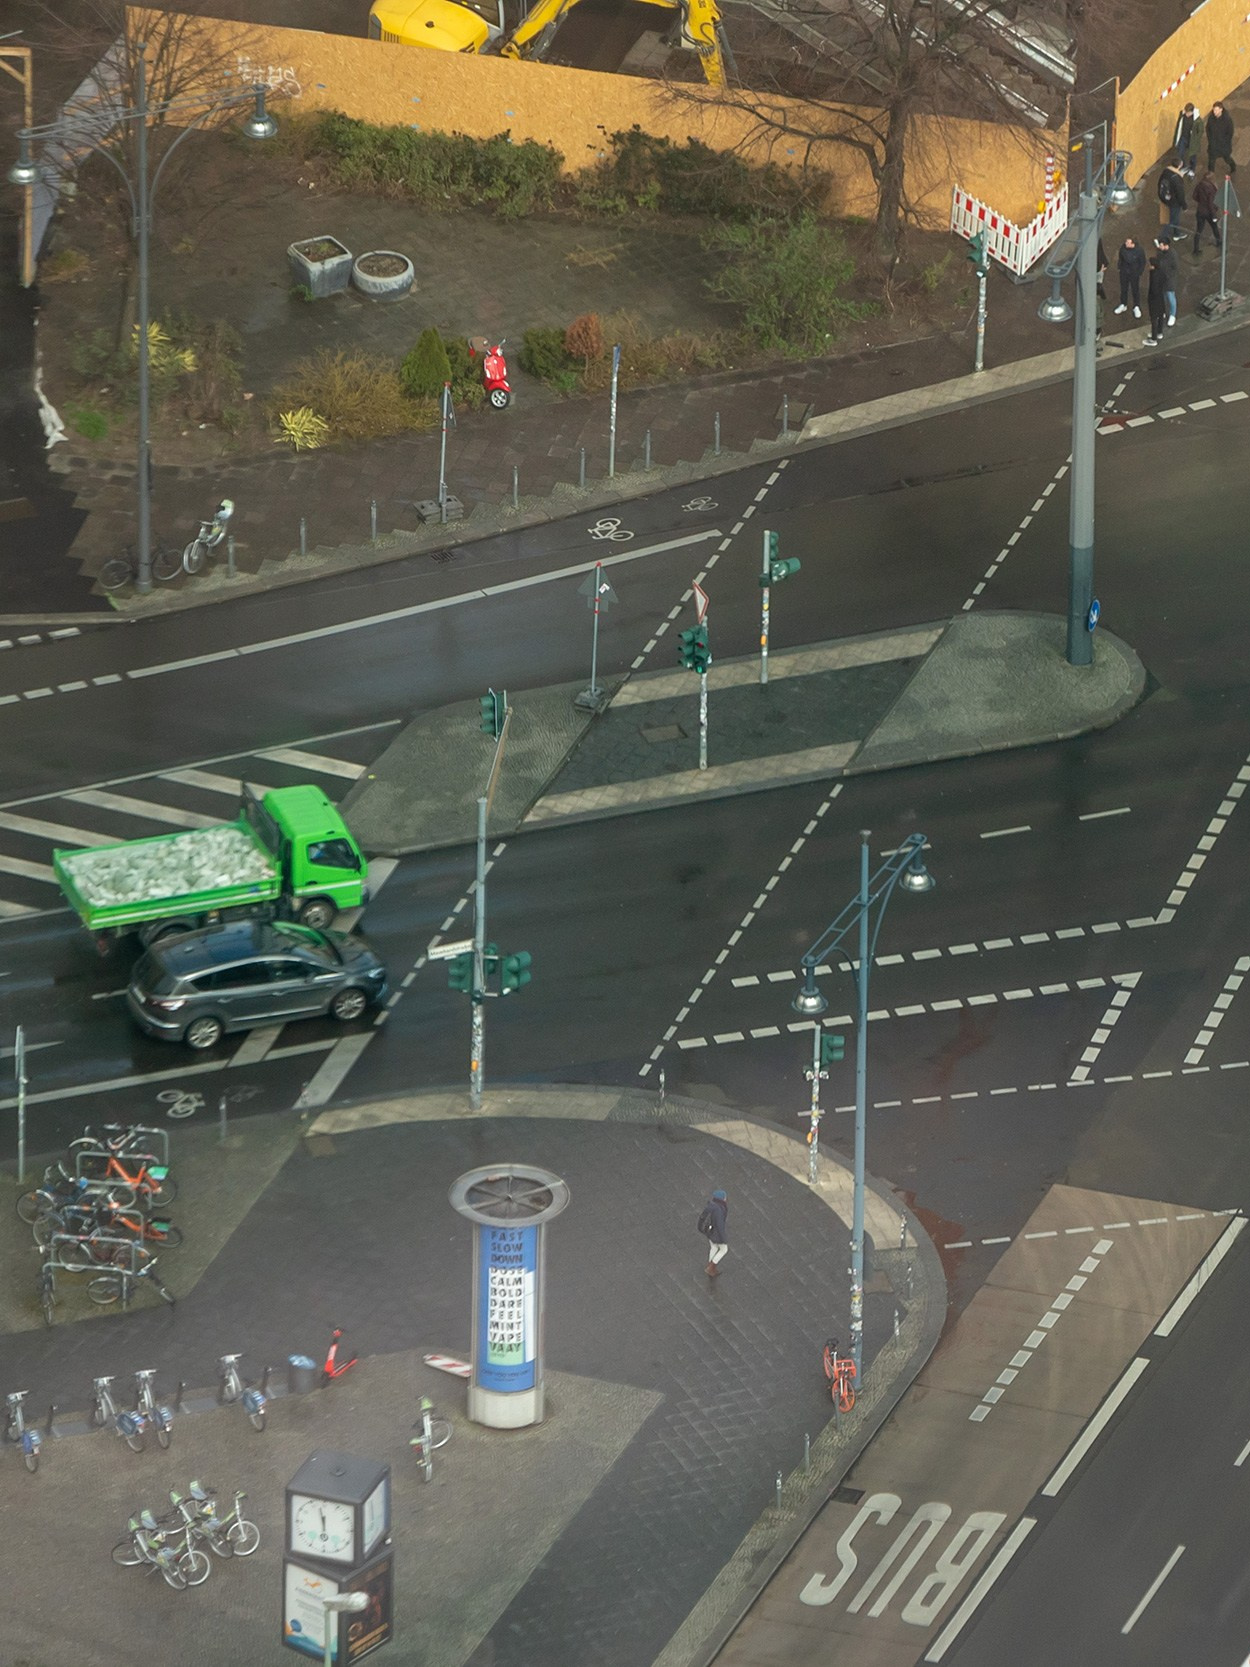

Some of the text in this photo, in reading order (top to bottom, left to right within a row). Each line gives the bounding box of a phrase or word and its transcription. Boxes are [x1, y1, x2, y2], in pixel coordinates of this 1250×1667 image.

[490, 1231, 523, 1241] FAST
[490, 1242, 523, 1253] SLOW
[490, 1254, 523, 1264] DOWN
[490, 1276, 522, 1286] CALM
[490, 1287, 522, 1297] BOLD
[490, 1299, 522, 1309] DARE
[490, 1309, 522, 1320] FEEL
[489, 1321, 522, 1331] MINT
[489, 1332, 522, 1342] VAPE
[489, 1342, 521, 1353] VAAY
[800, 1493, 1007, 1627] BUS
